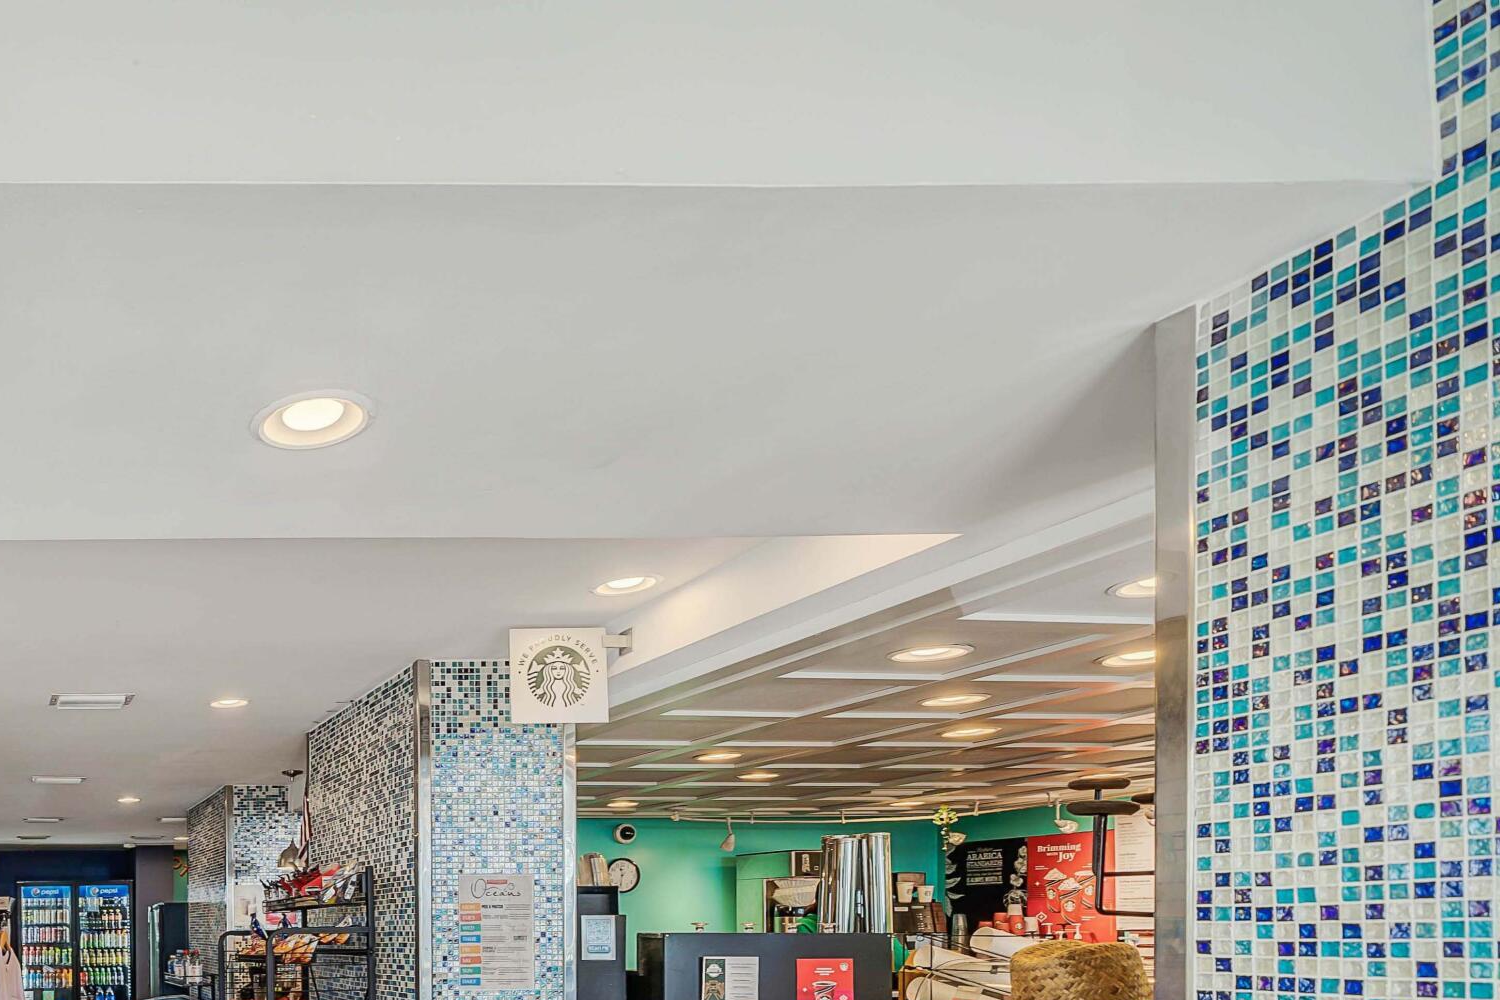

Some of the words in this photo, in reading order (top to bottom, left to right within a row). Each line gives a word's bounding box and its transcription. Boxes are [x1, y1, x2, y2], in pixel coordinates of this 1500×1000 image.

[575, 639, 598, 665] SERVE
[1037, 843, 1082, 852] Brimming
[1056, 851, 1076, 863] Joy
[41, 888, 60, 896] pepsi
[100, 887, 118, 895] pepsi
